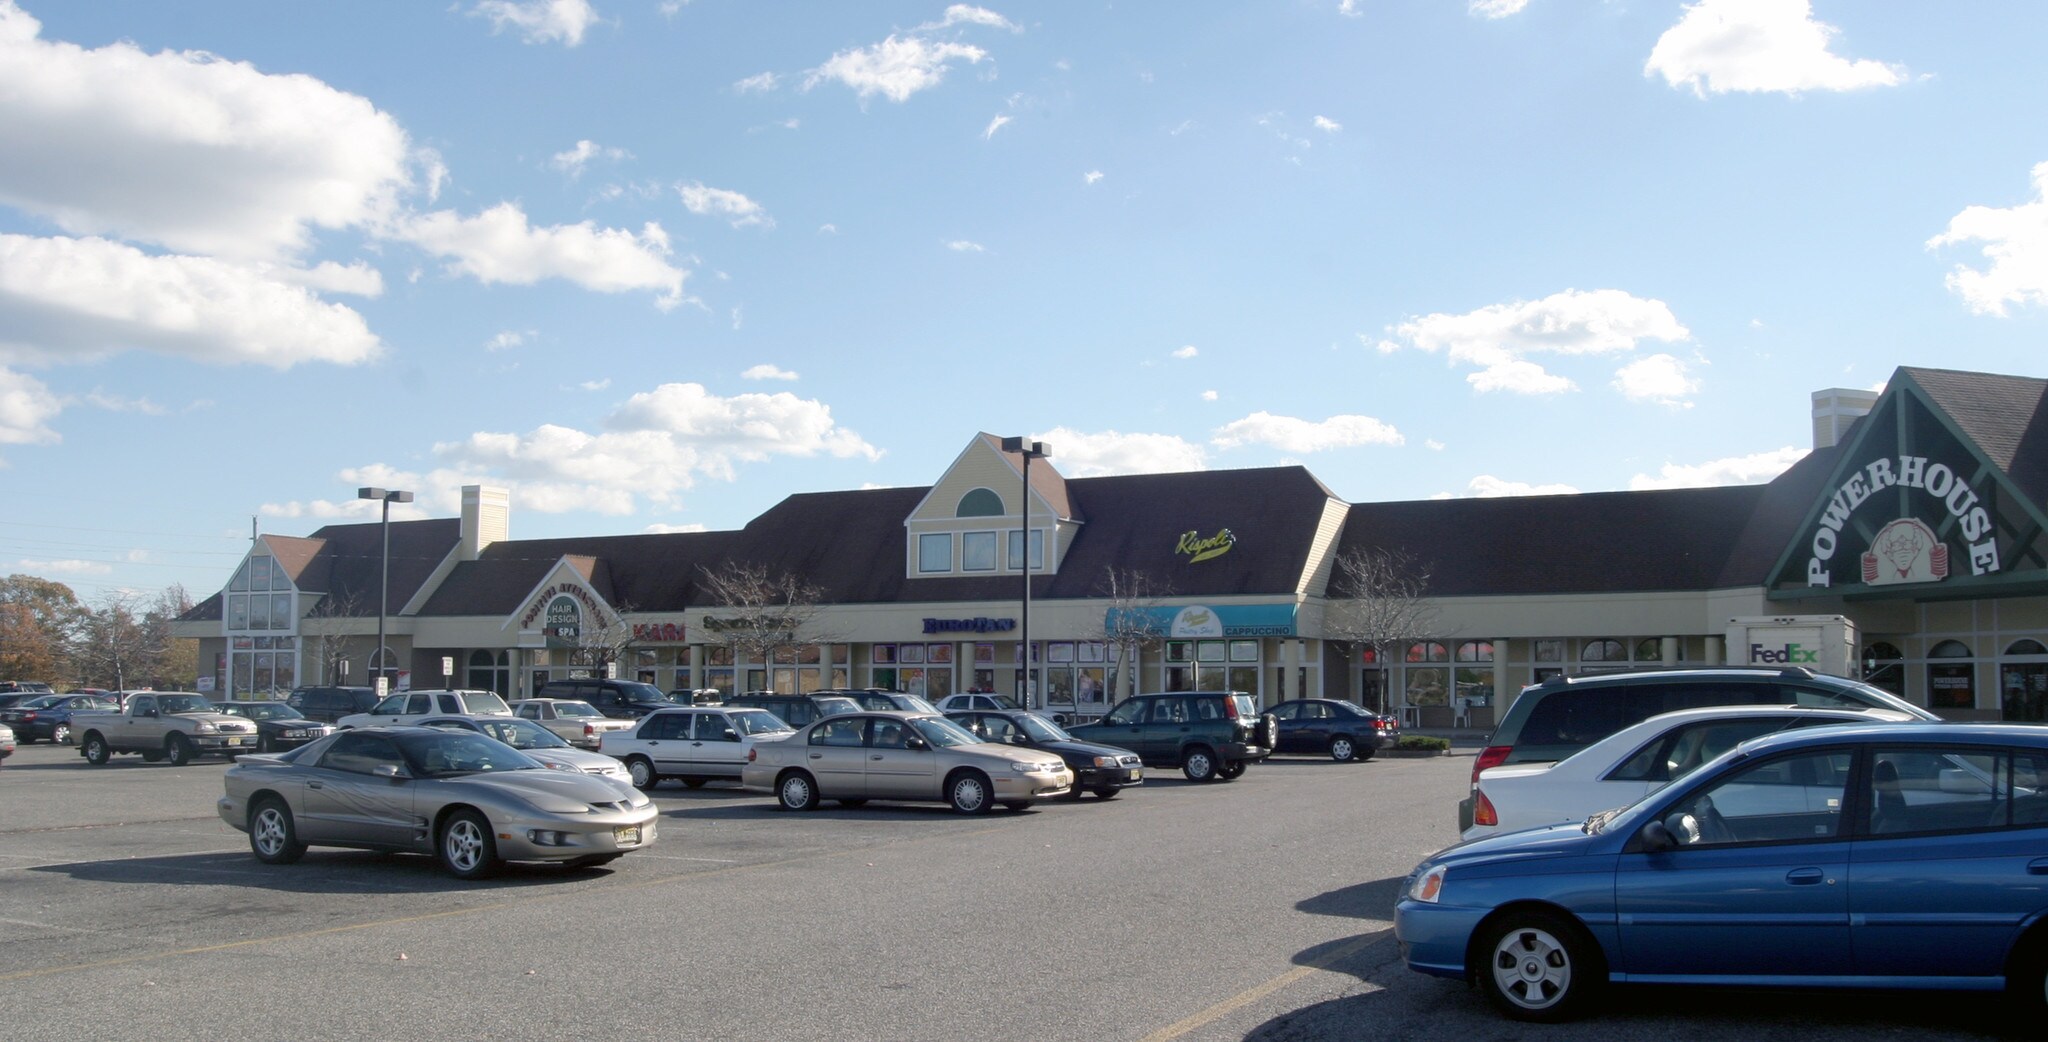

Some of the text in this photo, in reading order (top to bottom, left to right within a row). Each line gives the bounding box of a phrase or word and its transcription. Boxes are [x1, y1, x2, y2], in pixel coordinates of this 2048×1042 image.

[1808, 455, 2000, 588] POWERHOUSE
[552, 605, 572, 613] HAIR
[547, 614, 578, 623] DESIGN
[558, 627, 575, 636] SPA
[1225, 626, 1290, 636] CAPPUCCINO
[1751, 644, 1818, 663] FedEx
